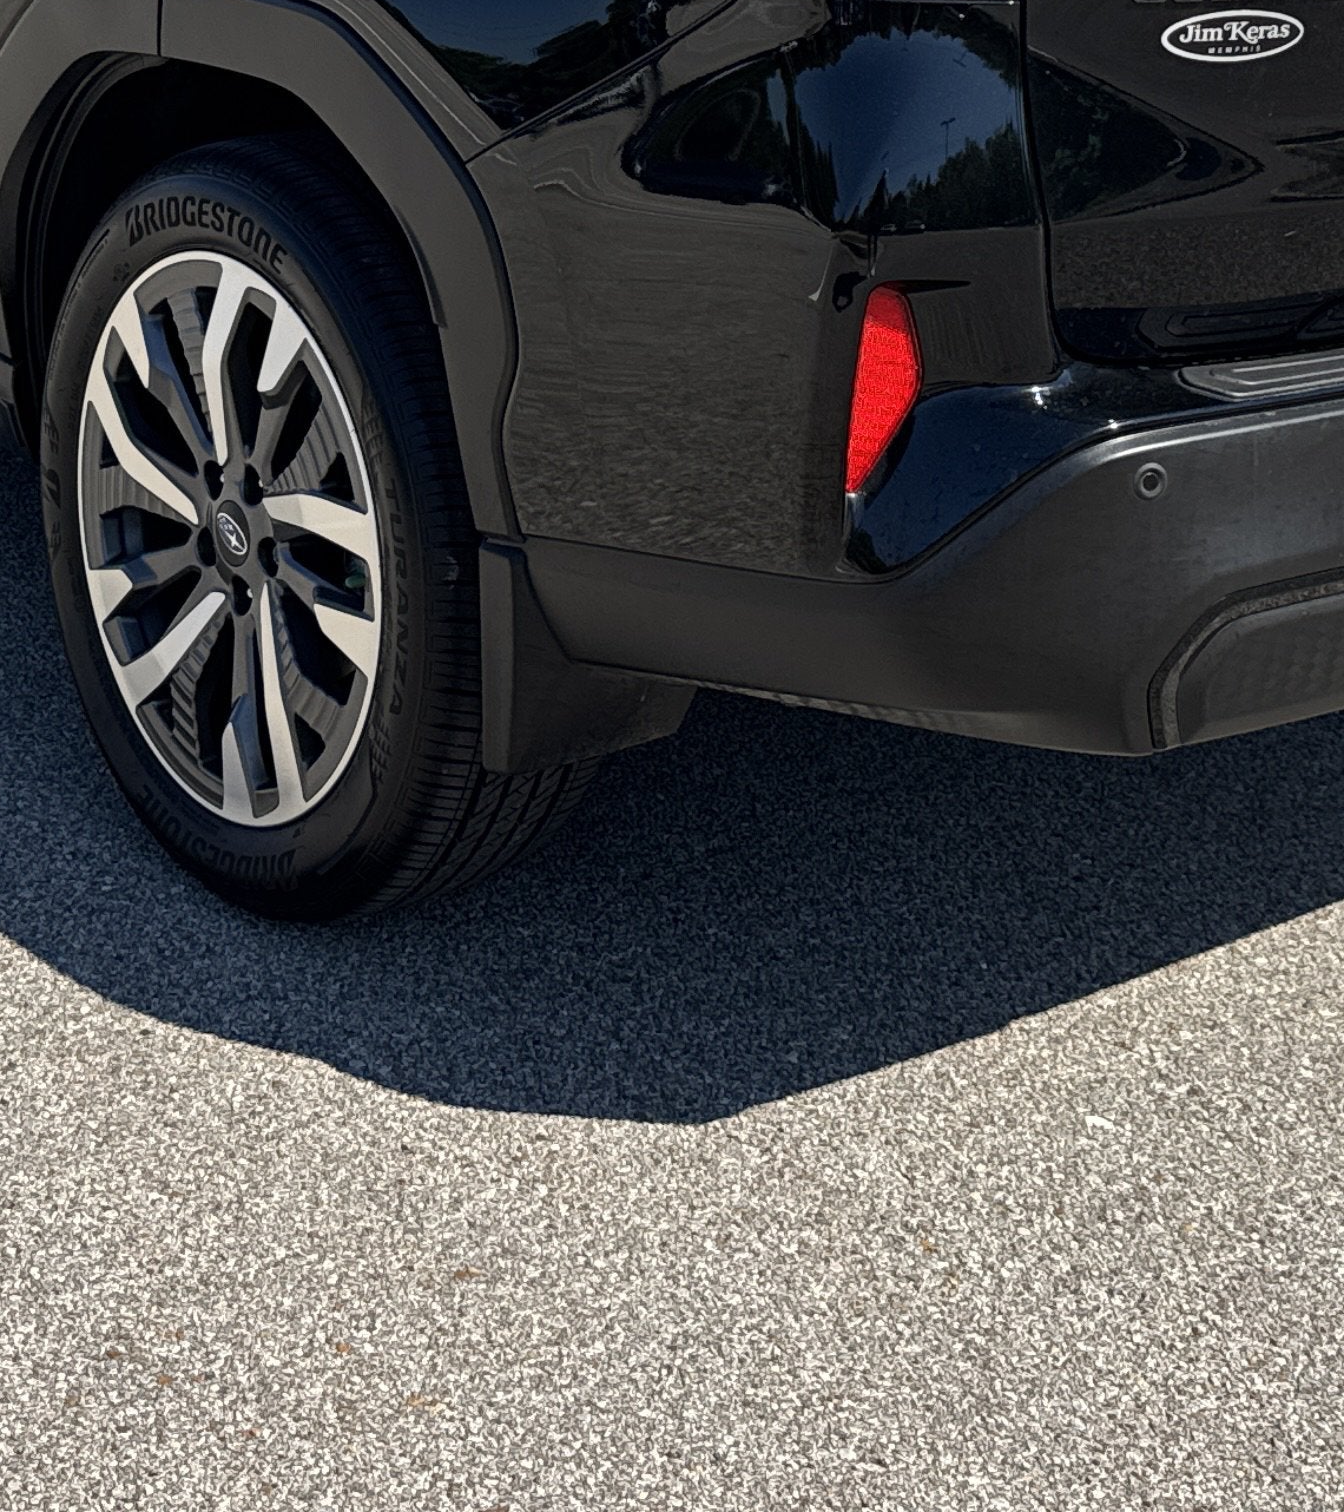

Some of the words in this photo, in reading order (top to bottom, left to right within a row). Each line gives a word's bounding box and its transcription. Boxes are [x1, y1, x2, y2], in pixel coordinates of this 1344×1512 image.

[1179, 24, 1223, 43] Jim
[1224, 21, 1291, 44] Keras
[1208, 45, 1261, 54] MEMPHIS
[125, 196, 289, 276] BRIDGESTONE
[385, 478, 408, 716] TURANZA
